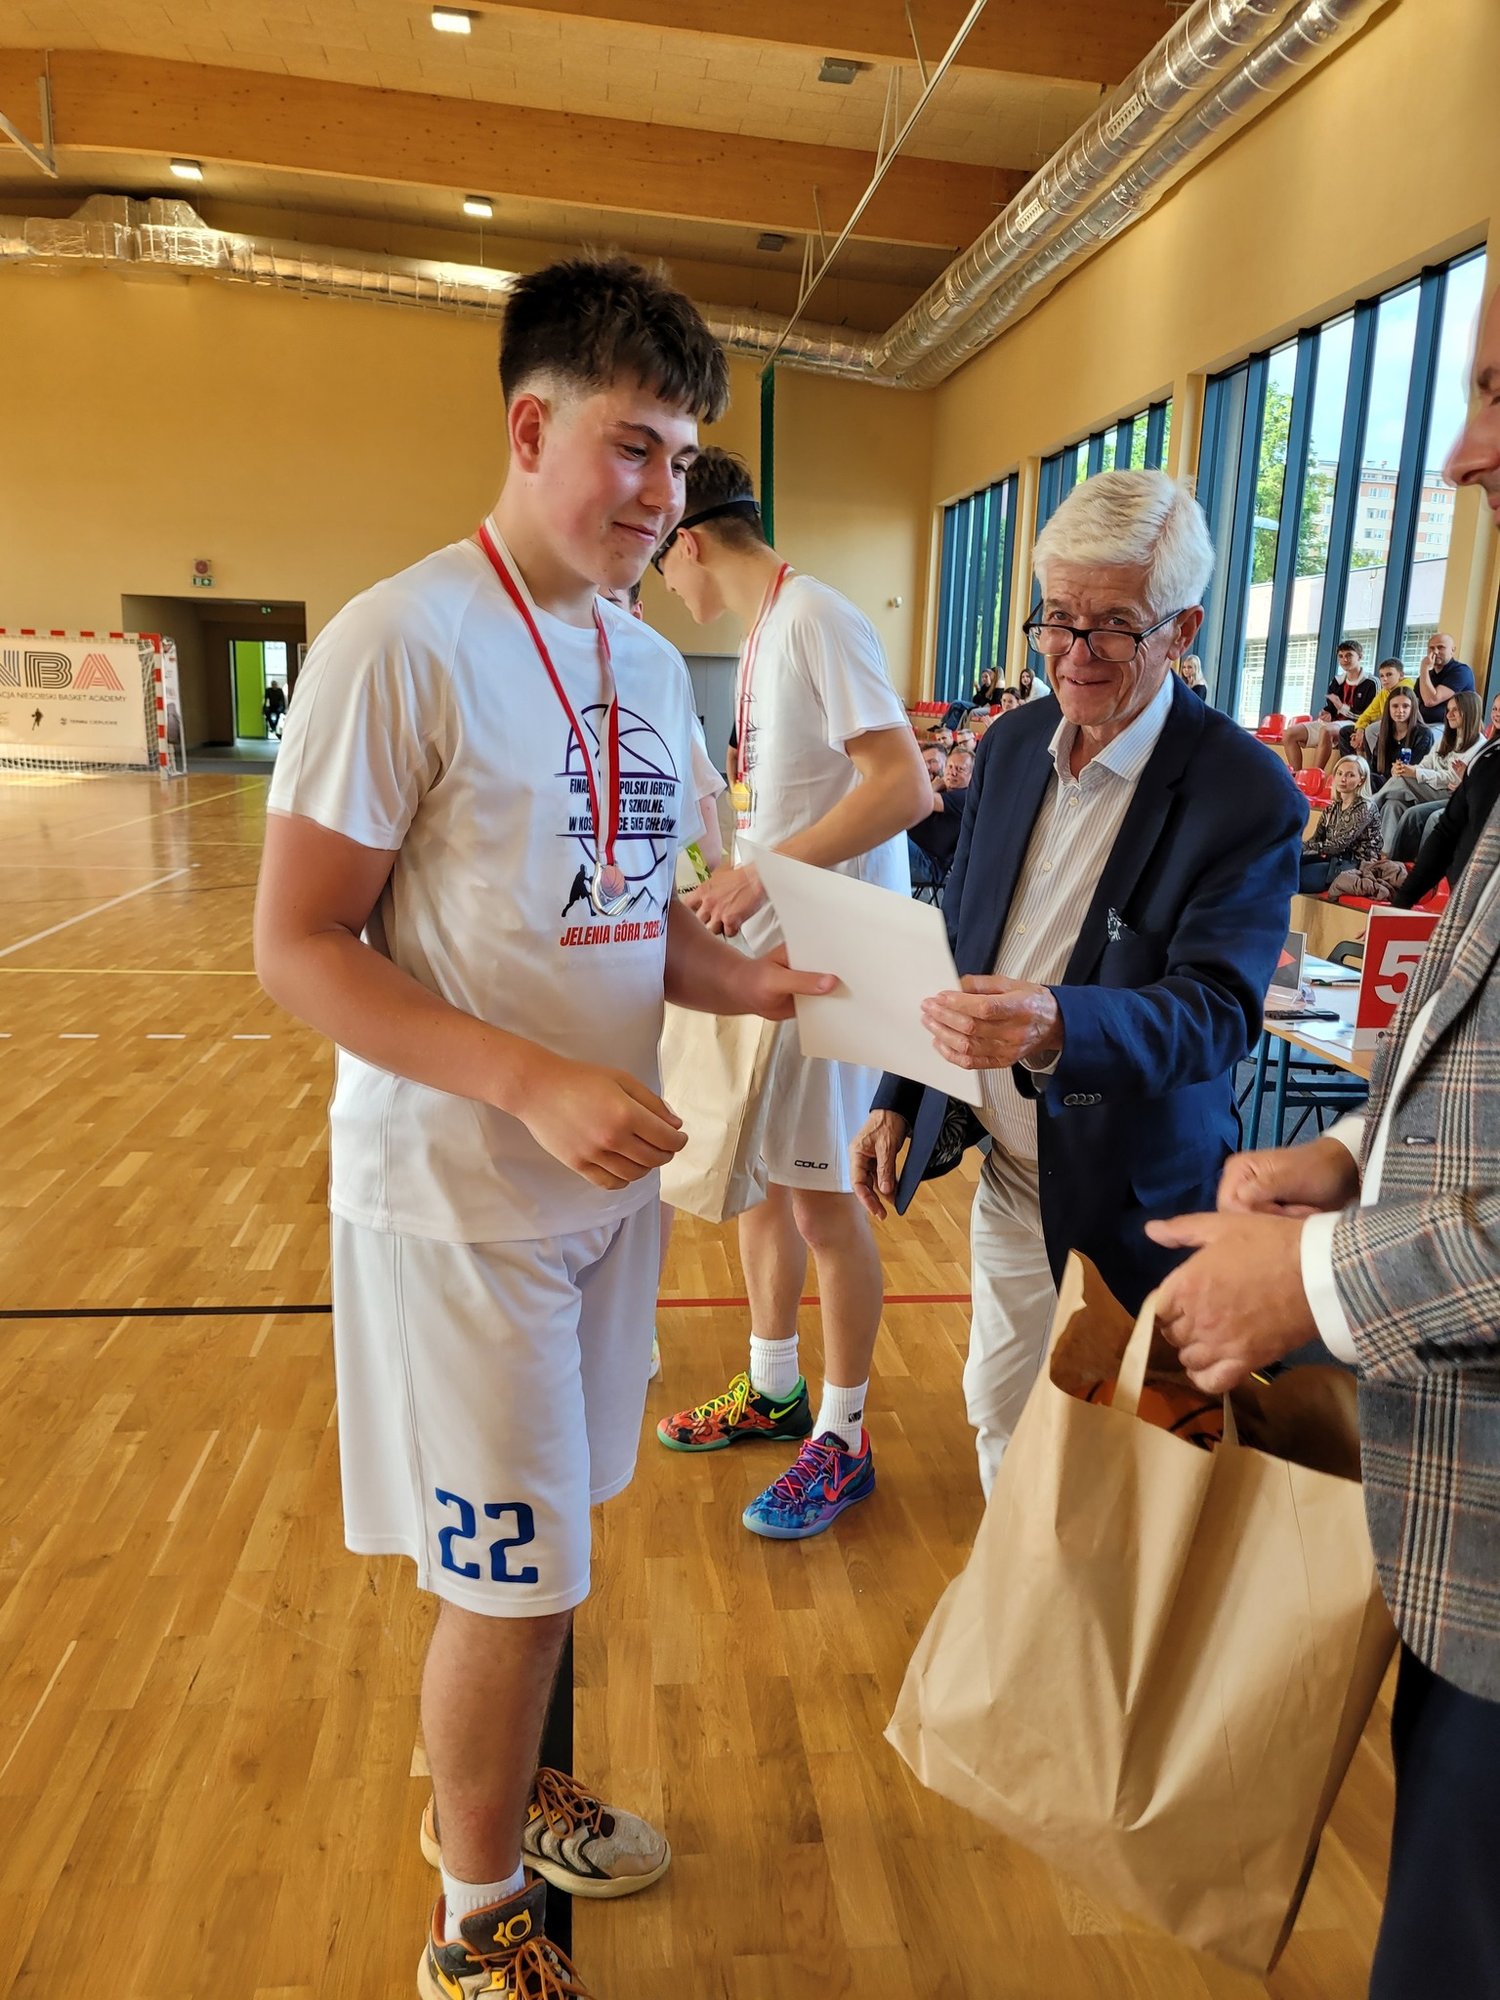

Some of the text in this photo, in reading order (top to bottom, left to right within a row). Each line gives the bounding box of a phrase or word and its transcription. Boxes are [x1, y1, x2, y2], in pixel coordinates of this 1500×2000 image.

[89, 694, 126, 703] ACADEMY
[569, 816, 578, 831] W
[560, 924, 611, 946] JELENIA
[614, 919, 641, 943] GÓRA
[794, 1159, 829, 1170] COLO
[435, 1487, 539, 1584] 22
